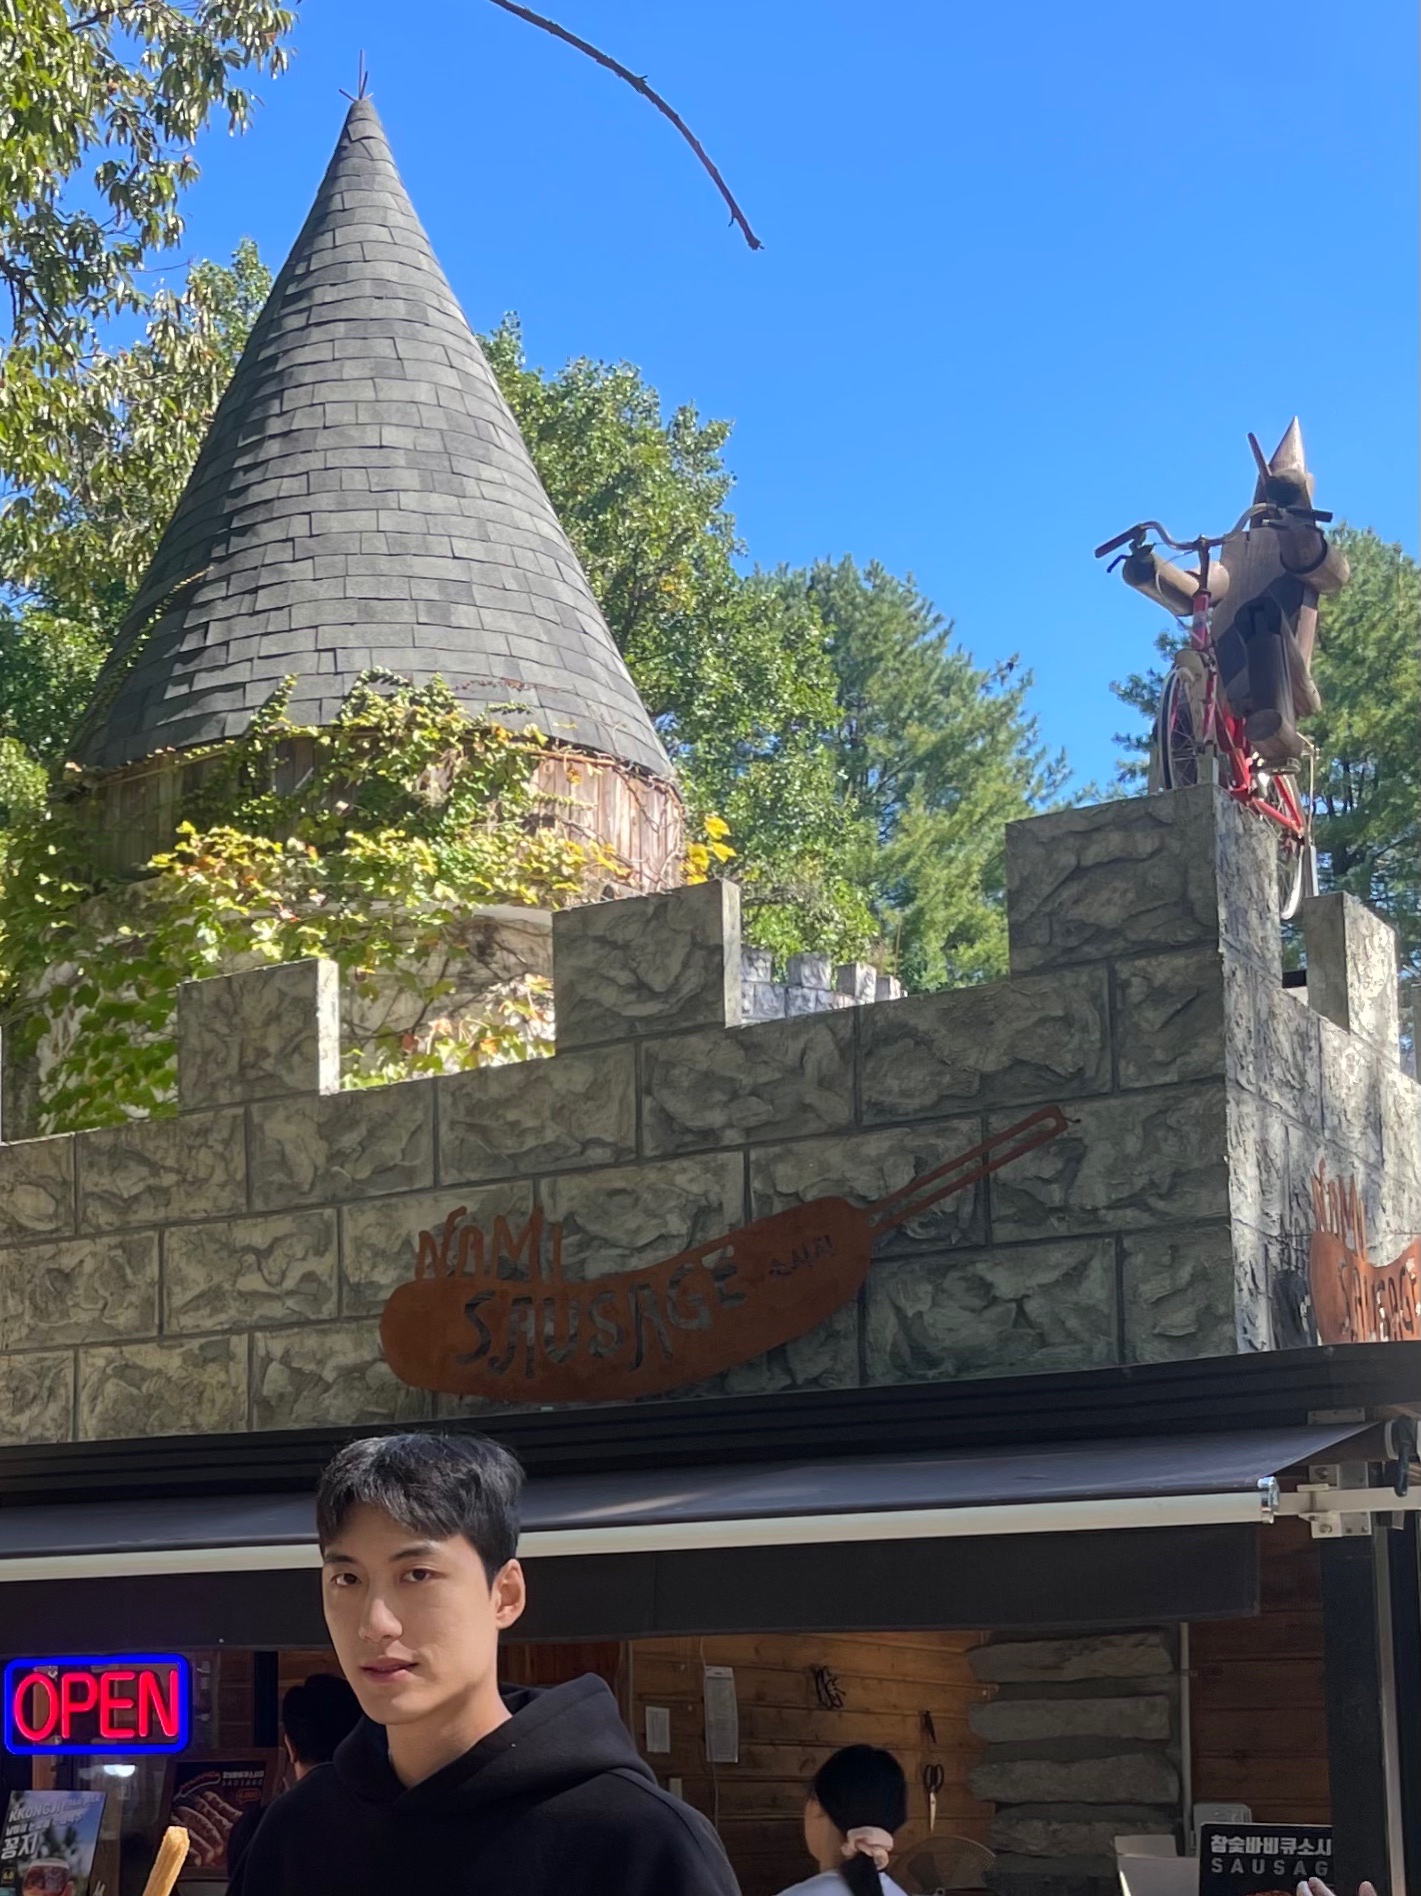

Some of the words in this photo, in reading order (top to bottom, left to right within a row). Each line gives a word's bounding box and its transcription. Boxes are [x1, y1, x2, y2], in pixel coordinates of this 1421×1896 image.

[457, 1245, 748, 1380] SAUSAGE
[13, 1669, 179, 1742] OPEN
[1210, 1857, 1329, 1877] SAUSAG
